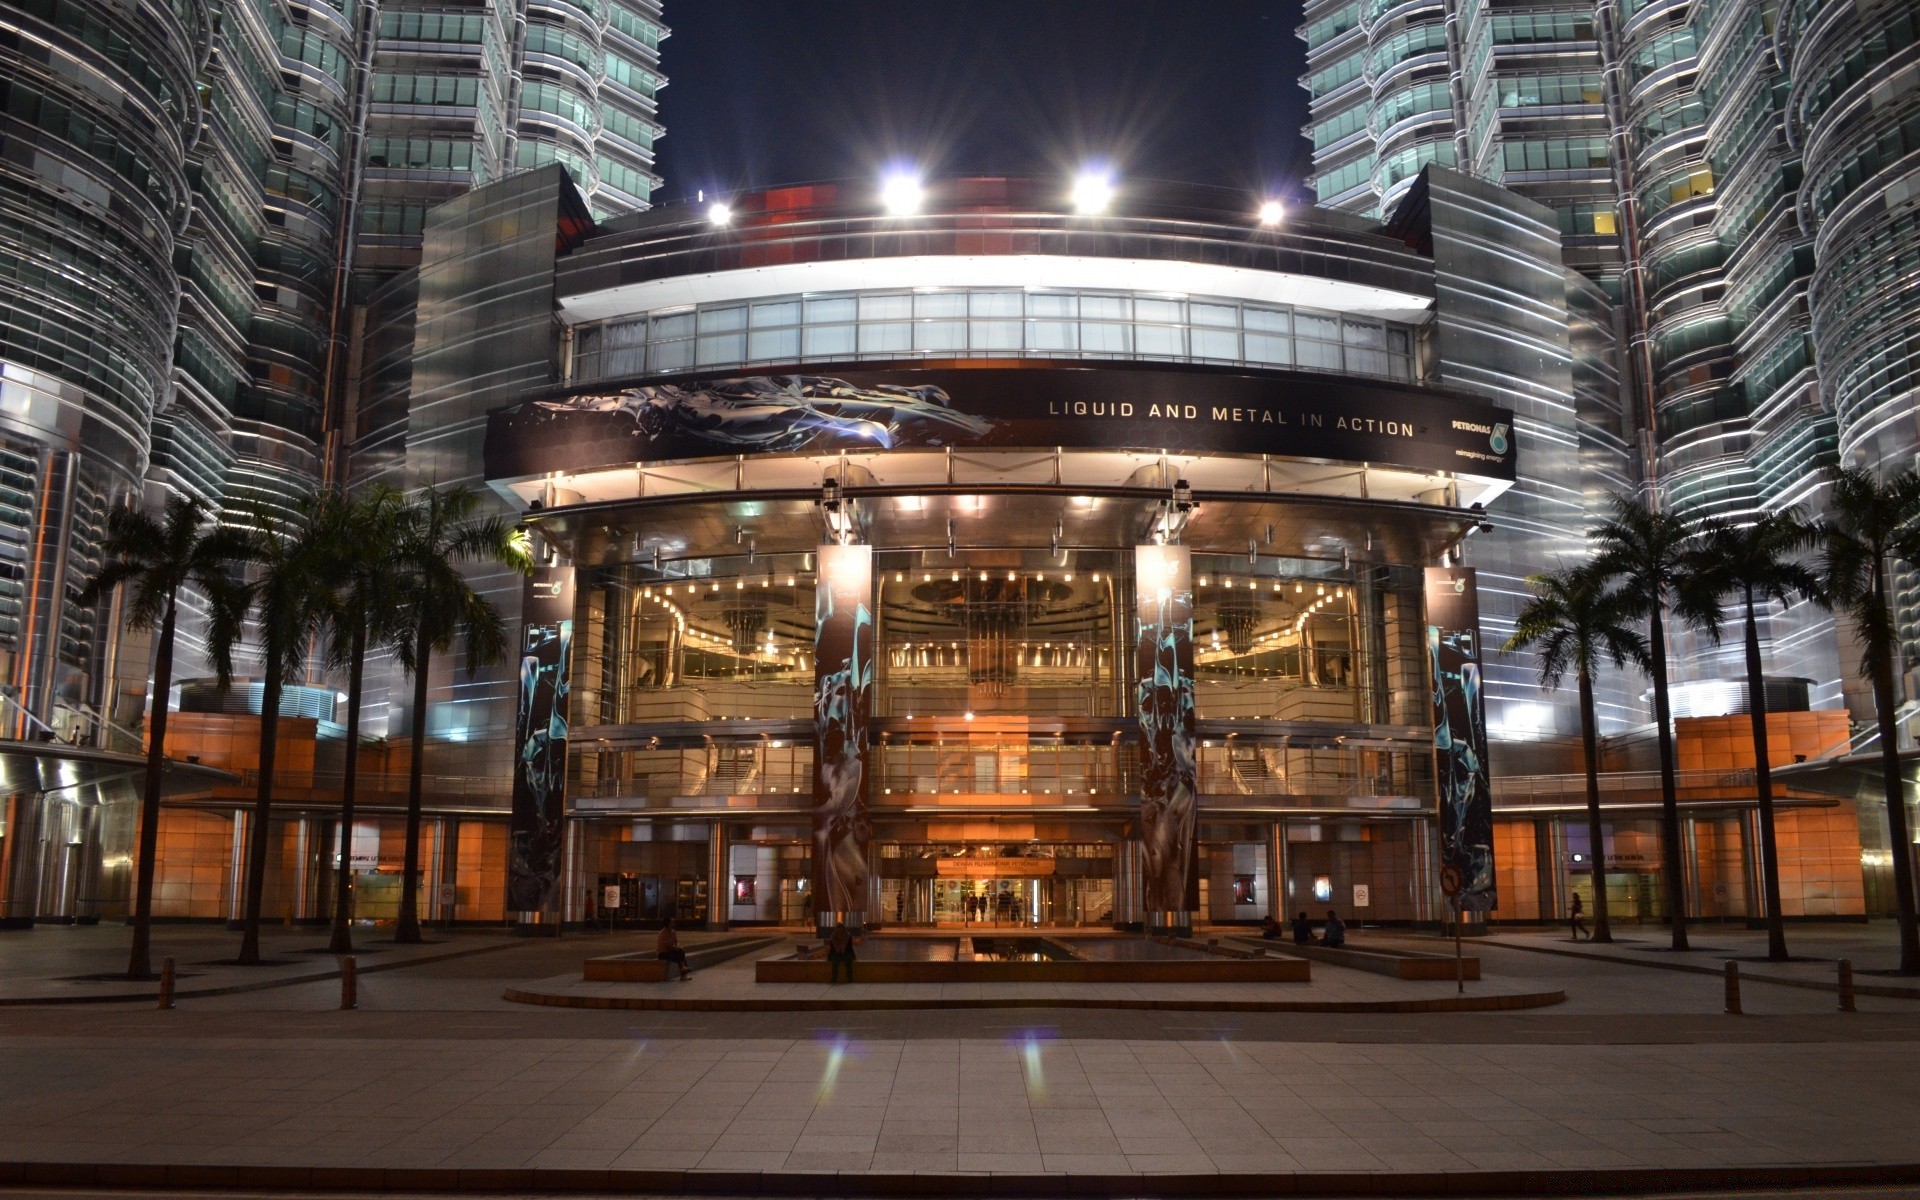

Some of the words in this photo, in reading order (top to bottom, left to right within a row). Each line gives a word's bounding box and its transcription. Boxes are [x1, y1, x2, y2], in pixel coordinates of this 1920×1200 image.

[1049, 401, 1134, 417] LIQUID
[1148, 403, 1197, 419] AND
[1212, 407, 1288, 424] METAL
[1301, 413, 1323, 427] IN
[1336, 416, 1413, 437] ACTION
[1452, 420, 1491, 434] PETRONAS
[1455, 449, 1486, 461] reimagining
